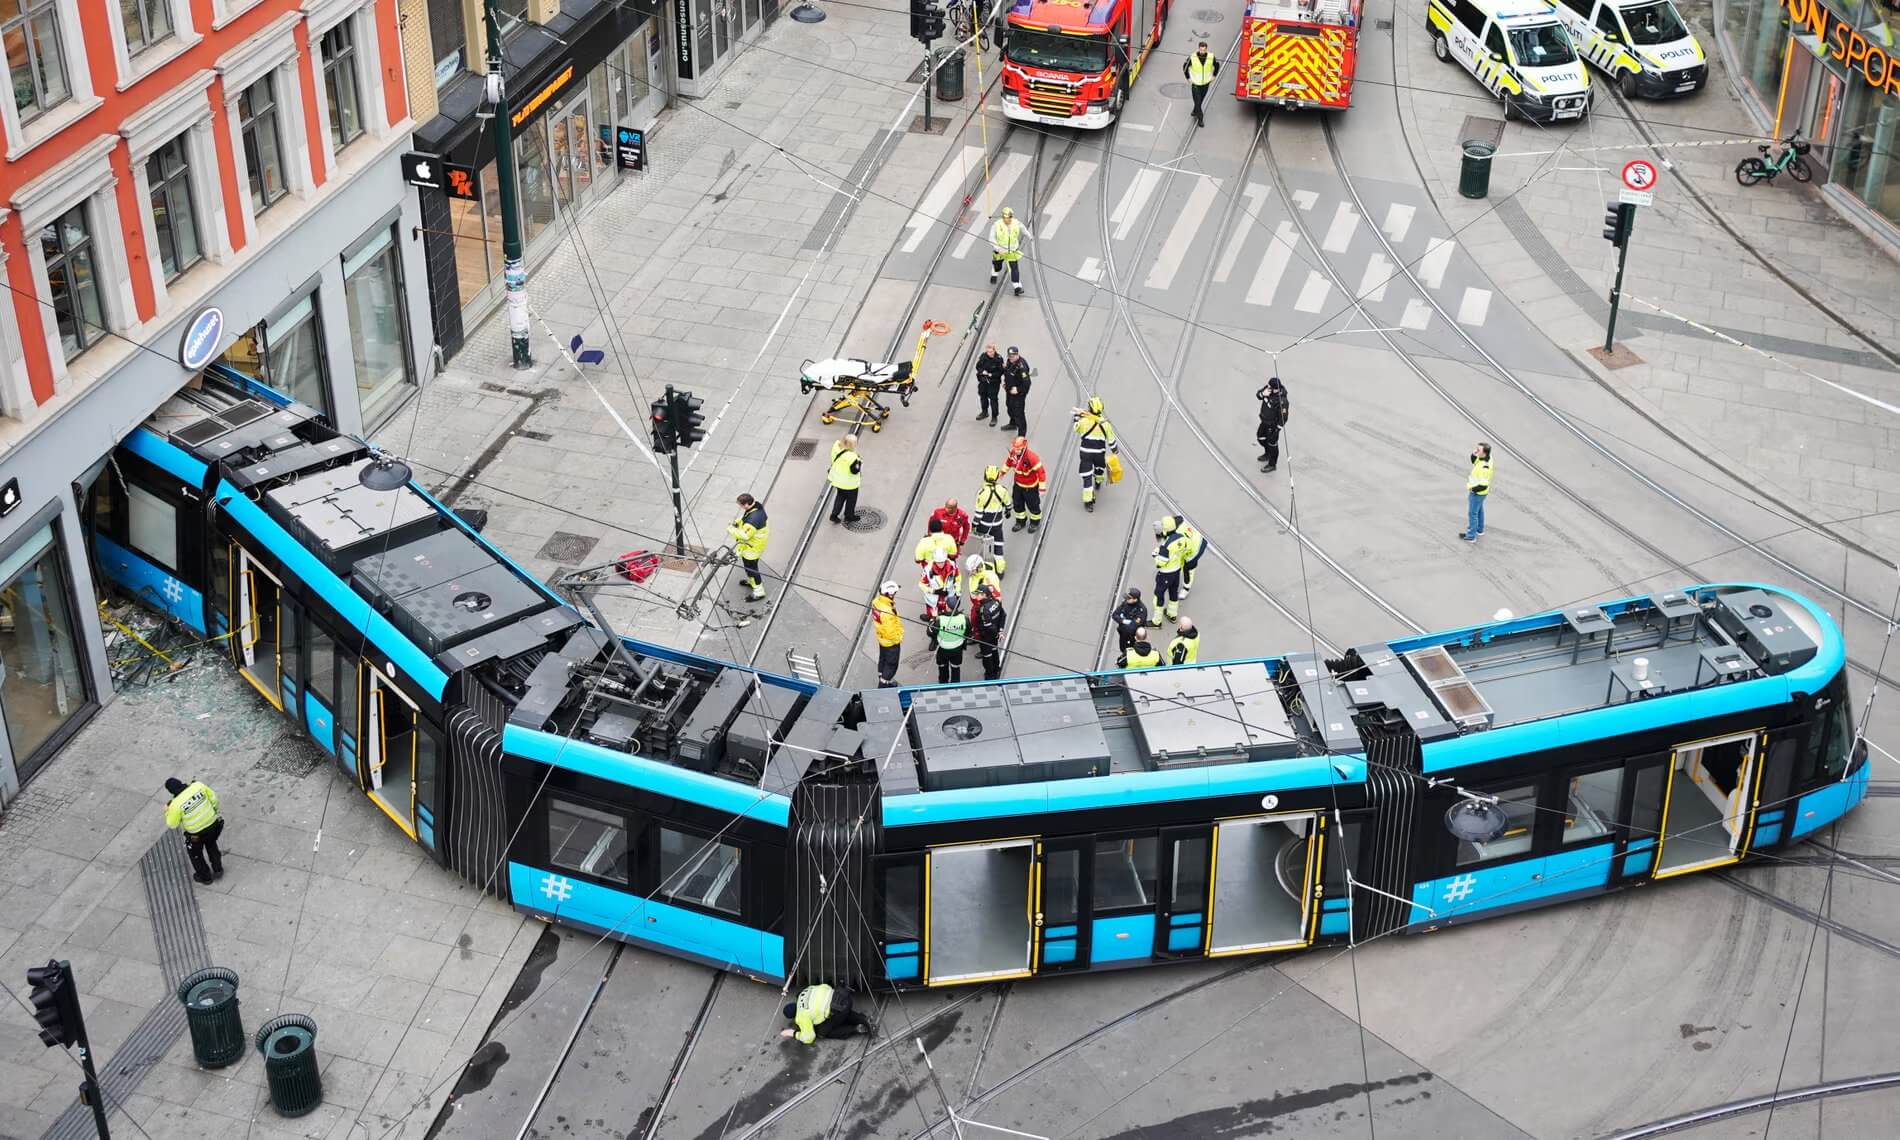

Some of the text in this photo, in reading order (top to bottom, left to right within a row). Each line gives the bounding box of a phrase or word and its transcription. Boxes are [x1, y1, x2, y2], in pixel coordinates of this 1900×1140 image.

[1454, 35, 1475, 60] POLITI
[1660, 47, 1695, 60] POLITI
[1036, 71, 1070, 81] SCANIA
[1541, 72, 1579, 83] POLITI
